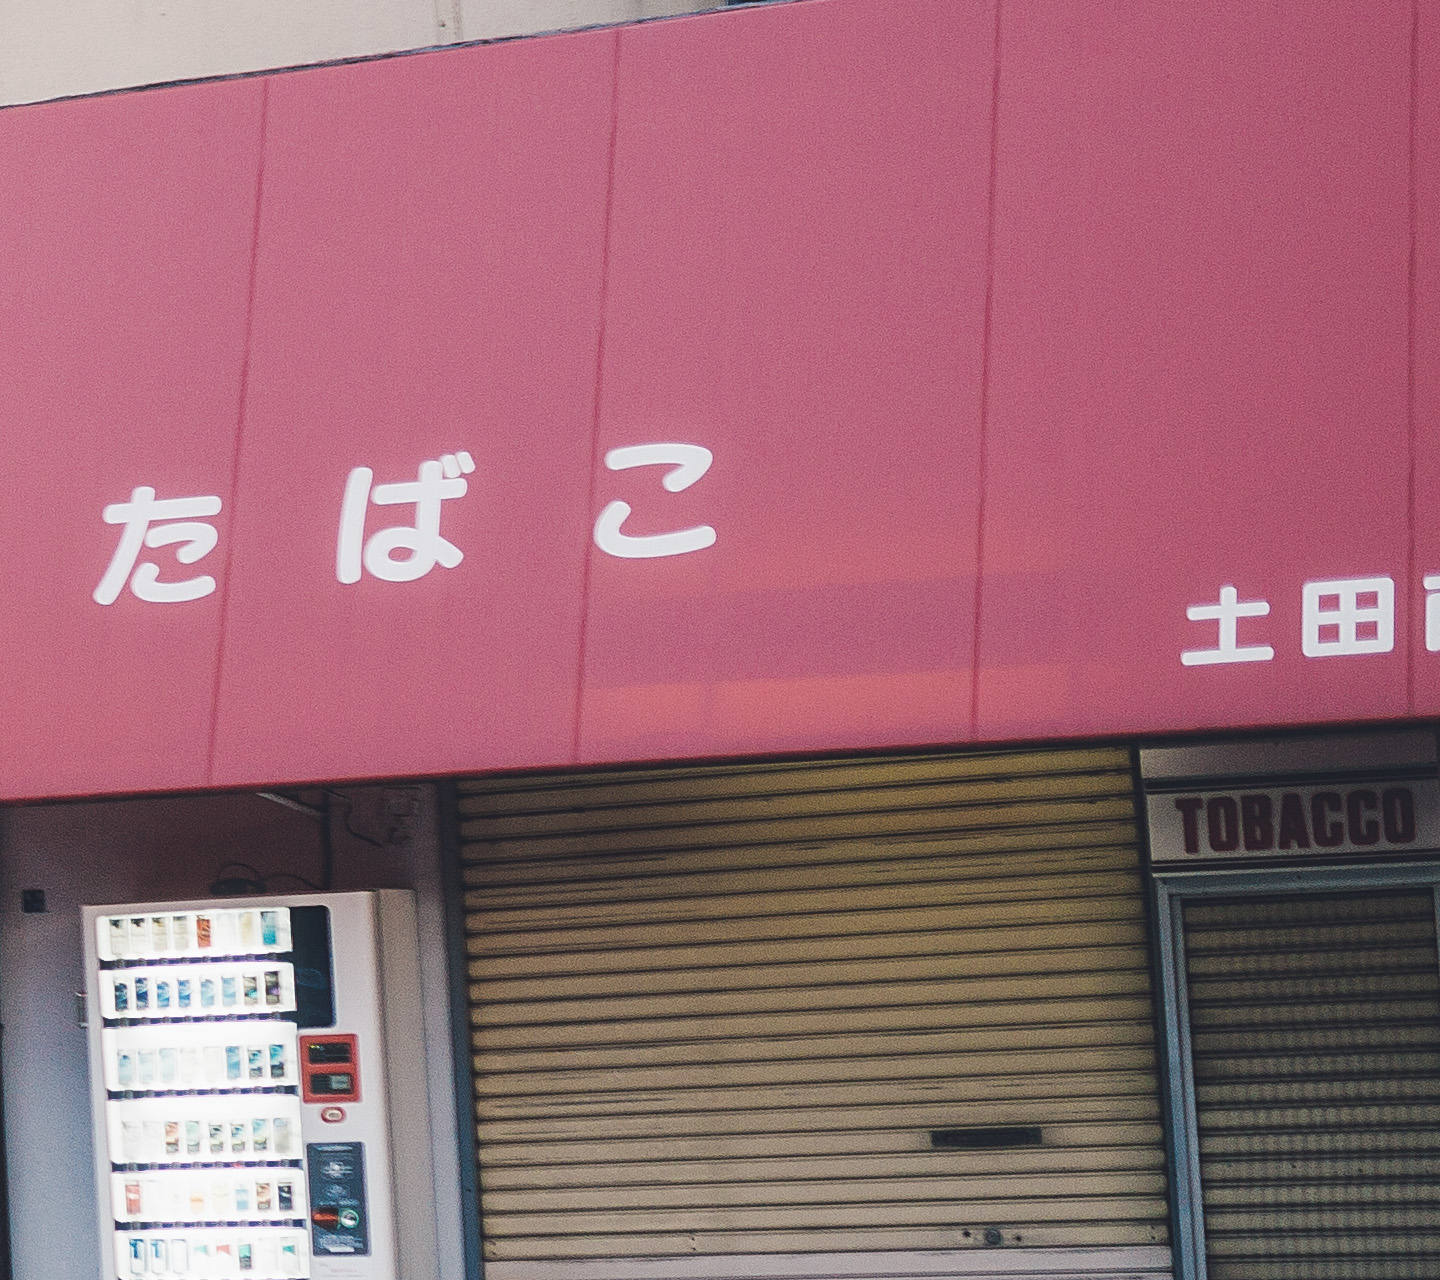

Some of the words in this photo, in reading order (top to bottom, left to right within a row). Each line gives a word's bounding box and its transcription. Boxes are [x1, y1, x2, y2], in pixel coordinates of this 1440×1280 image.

[94, 444, 716, 606] たばこ
[1180, 571, 1440, 667] 土田
[1174, 787, 1416, 855] TOBACCO
